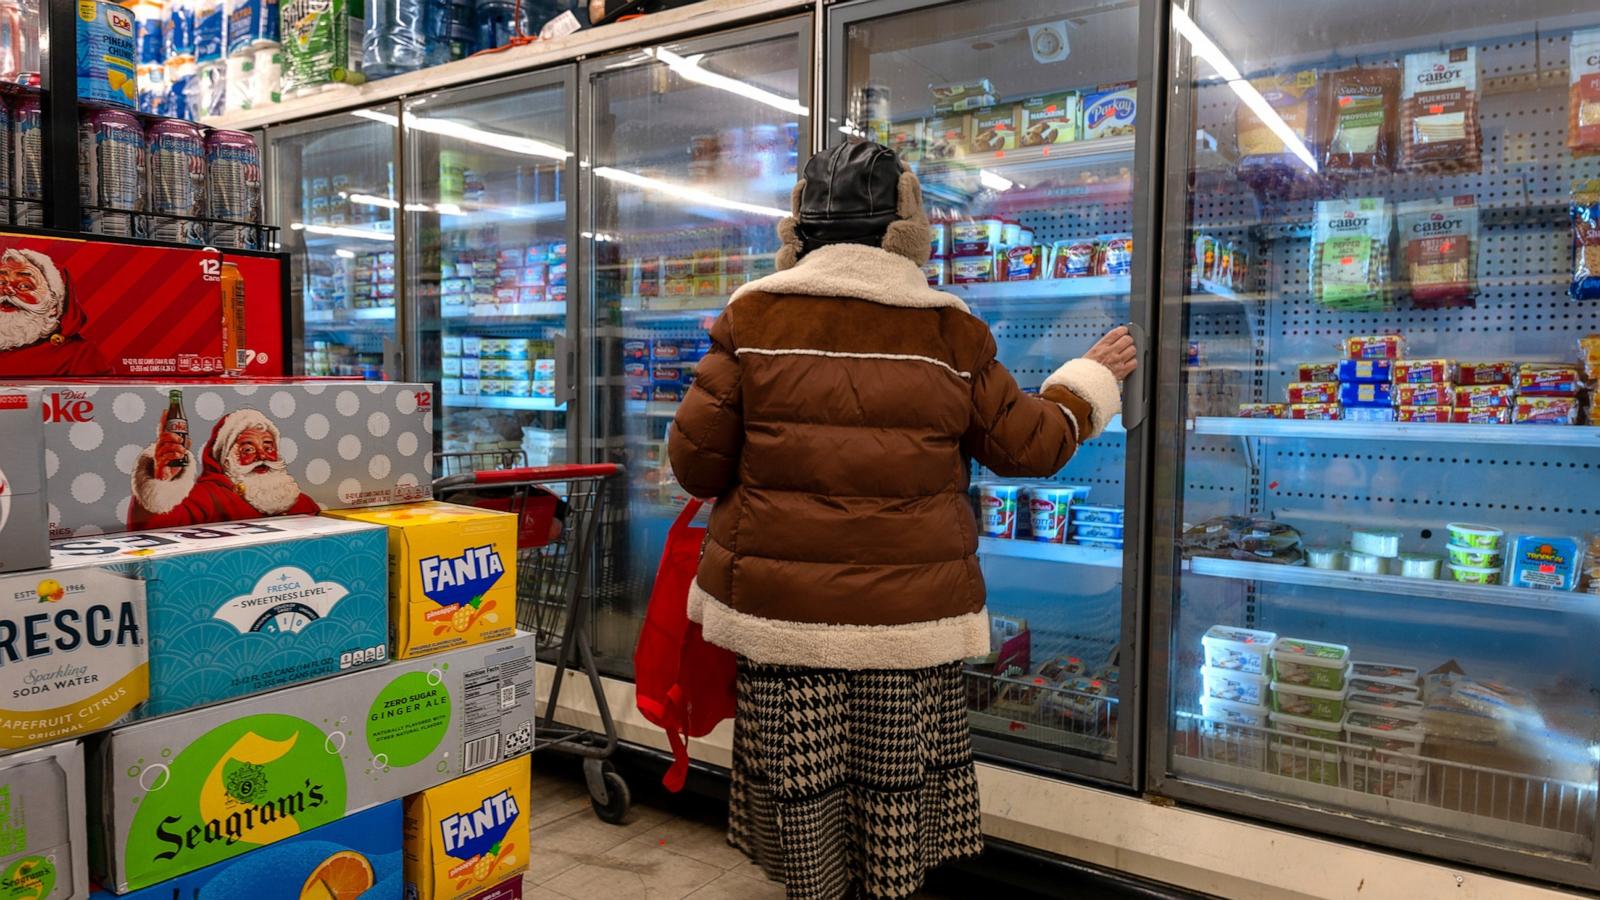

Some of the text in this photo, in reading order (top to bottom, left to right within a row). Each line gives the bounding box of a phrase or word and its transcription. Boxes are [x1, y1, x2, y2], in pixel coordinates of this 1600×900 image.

[199, 259, 221, 275] 12
[61, 390, 87, 400] Diet
[414, 391, 430, 406] 12
[420, 545, 504, 594] FANTA
[66, 583, 86, 592] 1966
[241, 587, 327, 609] SWEETNESS LEVEL
[267, 582, 301, 593] FRESCA
[23, 663, 89, 686] Sparkling
[12, 674, 99, 699] SODA WATER
[0, 687, 128, 731] APEFRUIT CITRUS
[371, 696, 447, 721] GINGER ALE
[384, 689, 437, 709] ZERO SUGAR
[28, 724, 84, 740] ORIGINAL
[153, 778, 325, 862] Seagram's
[441, 788, 519, 852] FANTA
